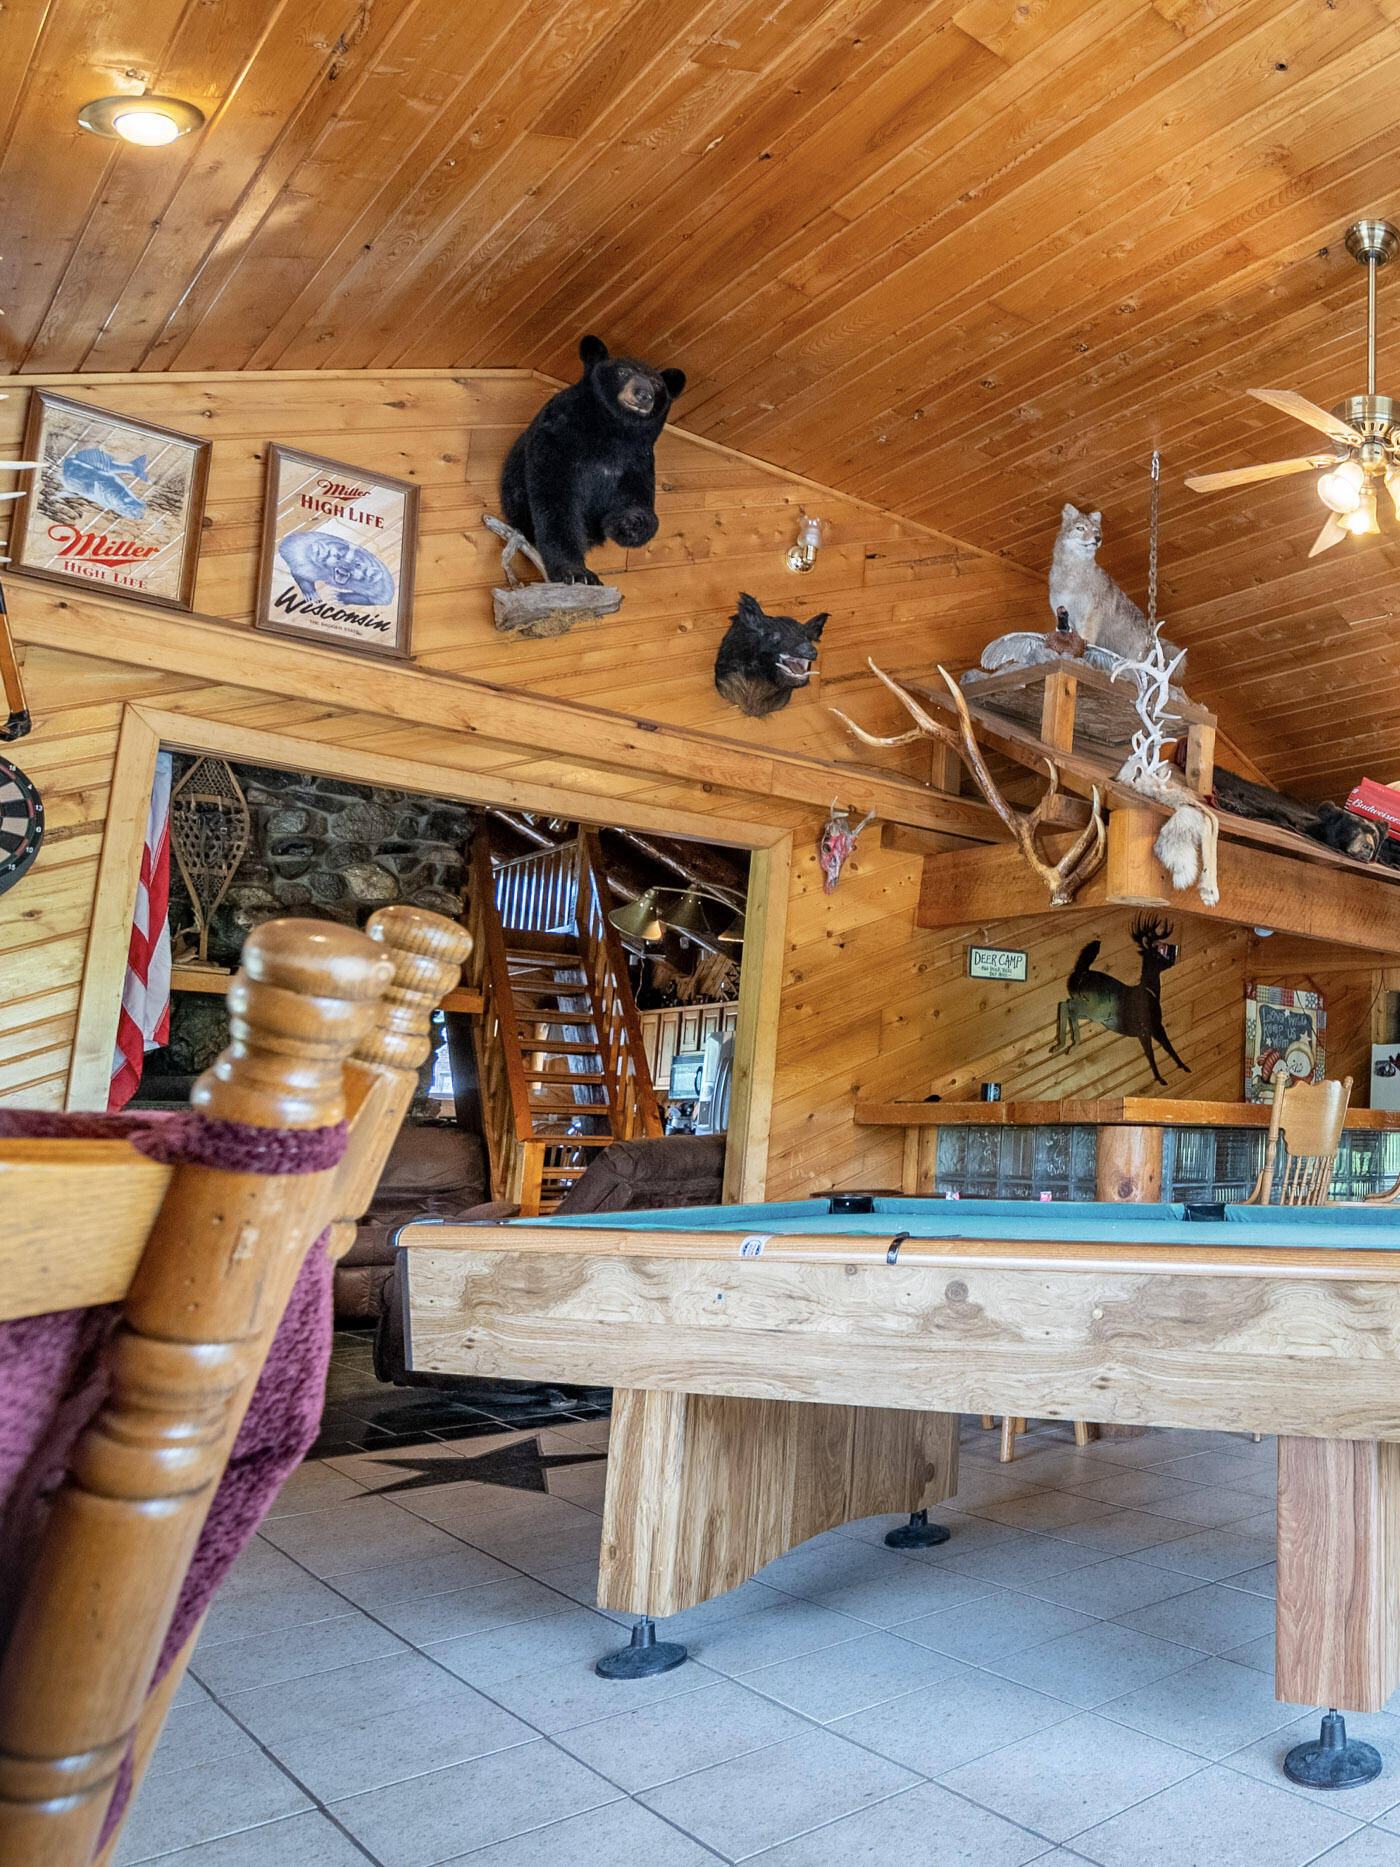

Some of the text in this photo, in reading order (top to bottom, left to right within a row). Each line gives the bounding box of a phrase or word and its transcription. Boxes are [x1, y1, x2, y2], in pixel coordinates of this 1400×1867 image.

[317, 479, 371, 497] Miller
[301, 494, 385, 529] HIGH LIFE
[47, 524, 160, 558] Miller
[63, 560, 148, 590] HIGH LIFE
[274, 585, 392, 632] Wisconsin
[1351, 798, 1400, 825] Budweiser
[974, 951, 1023, 969] DEER CAMP
